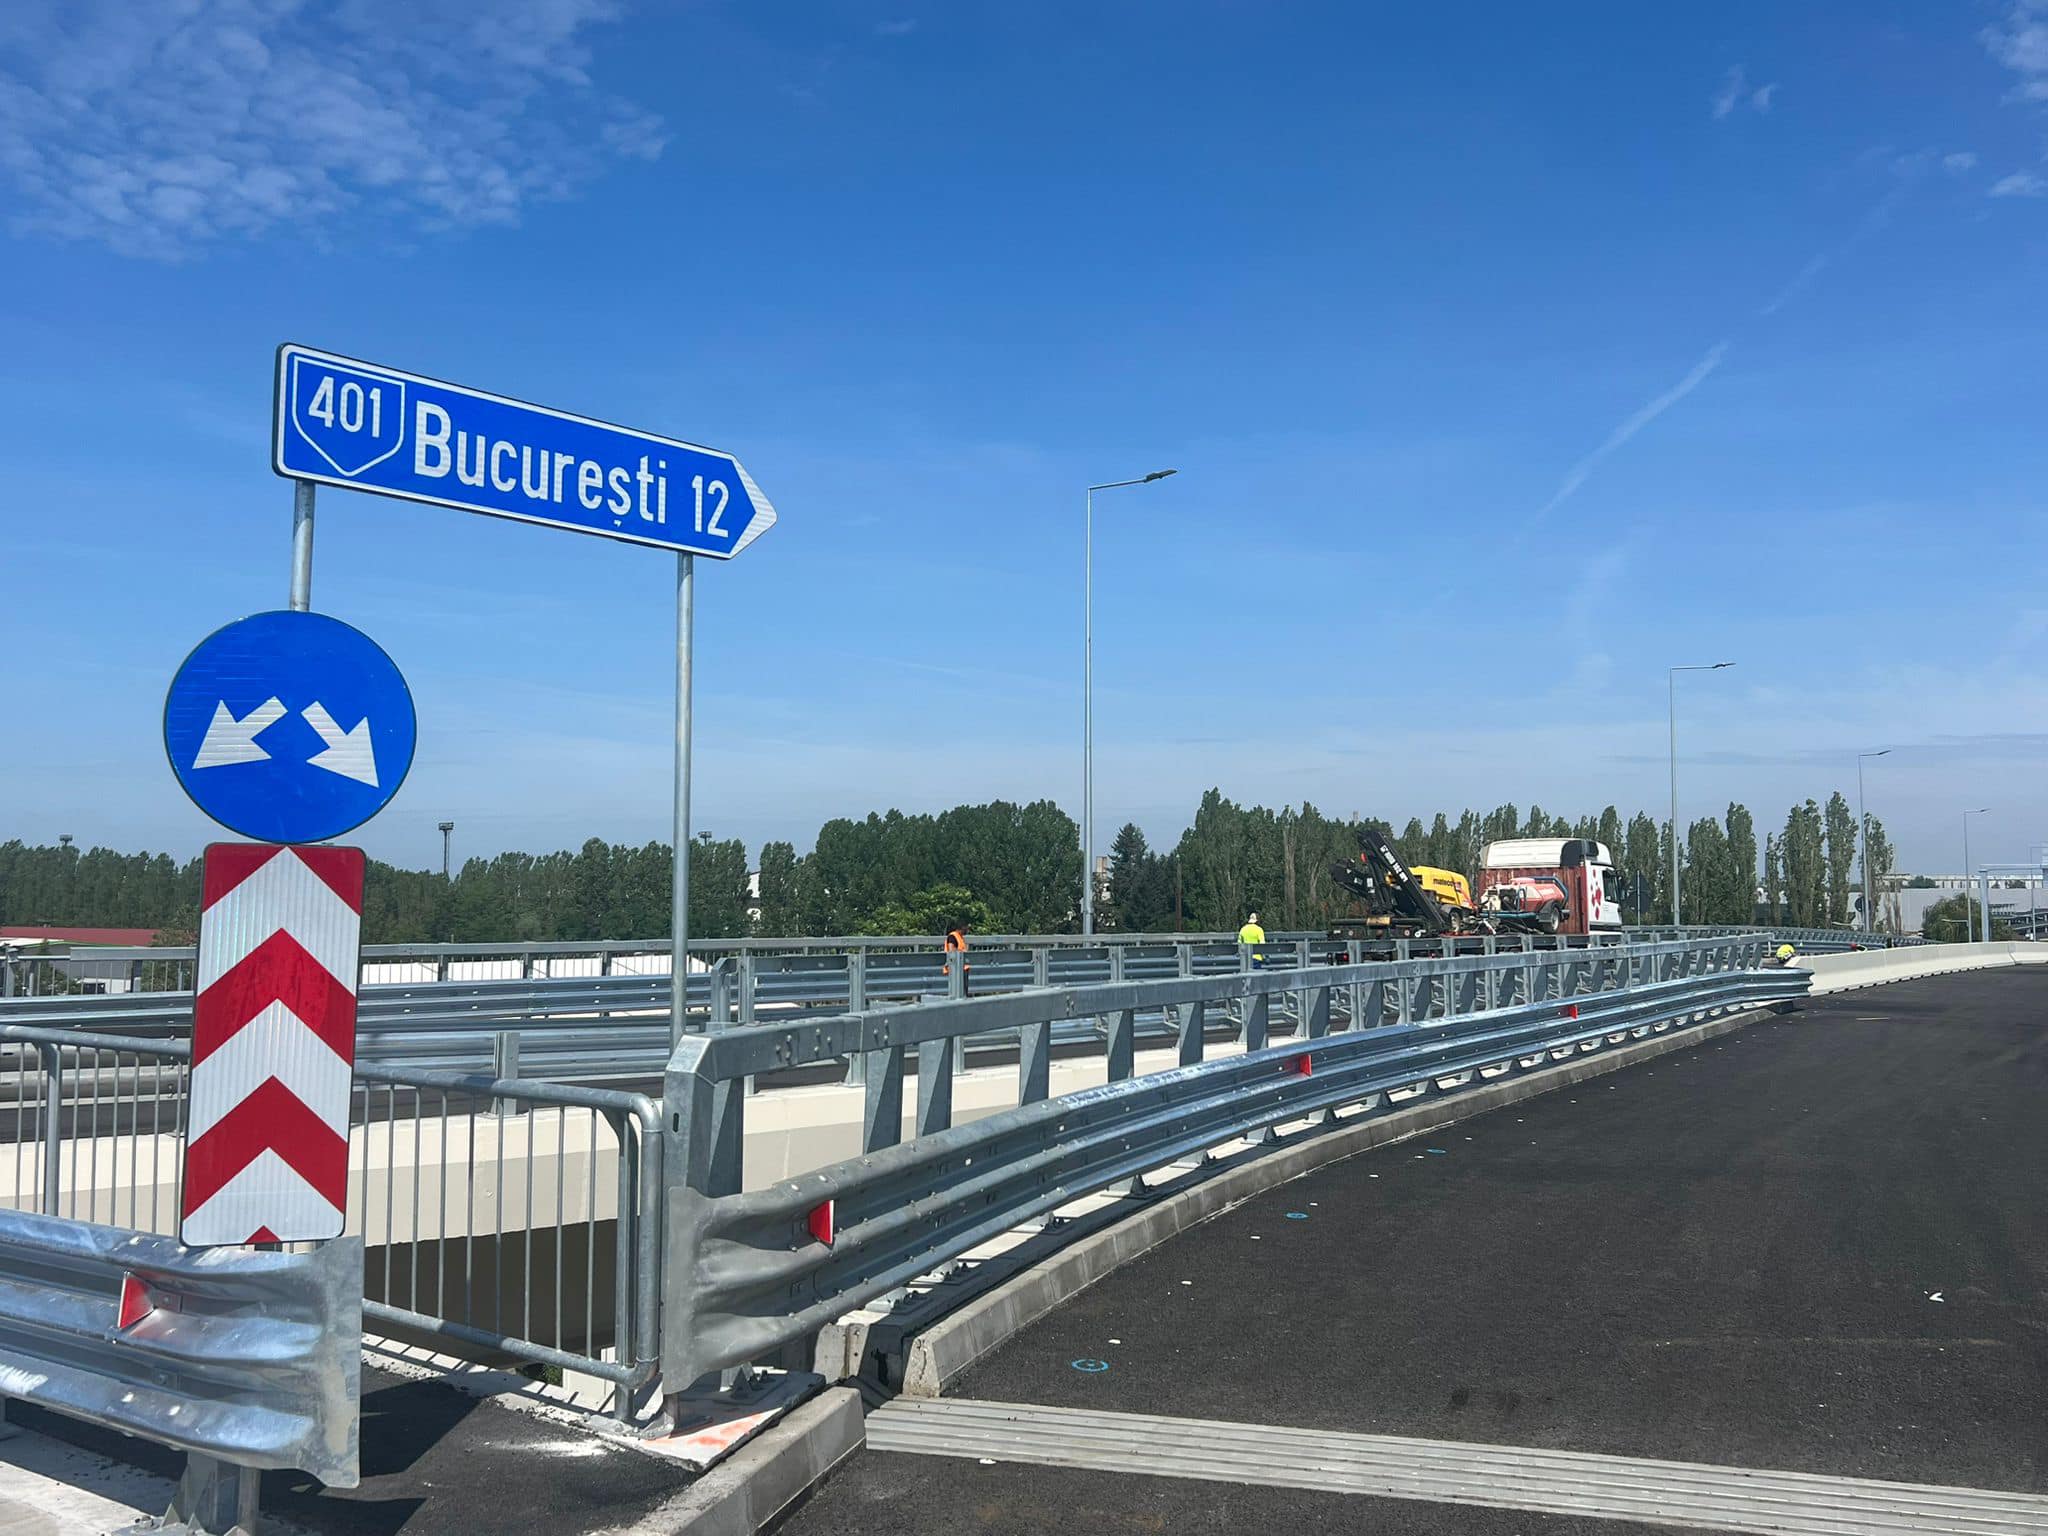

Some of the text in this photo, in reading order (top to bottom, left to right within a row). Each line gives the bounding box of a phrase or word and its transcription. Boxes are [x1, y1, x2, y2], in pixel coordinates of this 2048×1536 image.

[308, 376, 729, 538] 401 București 12
